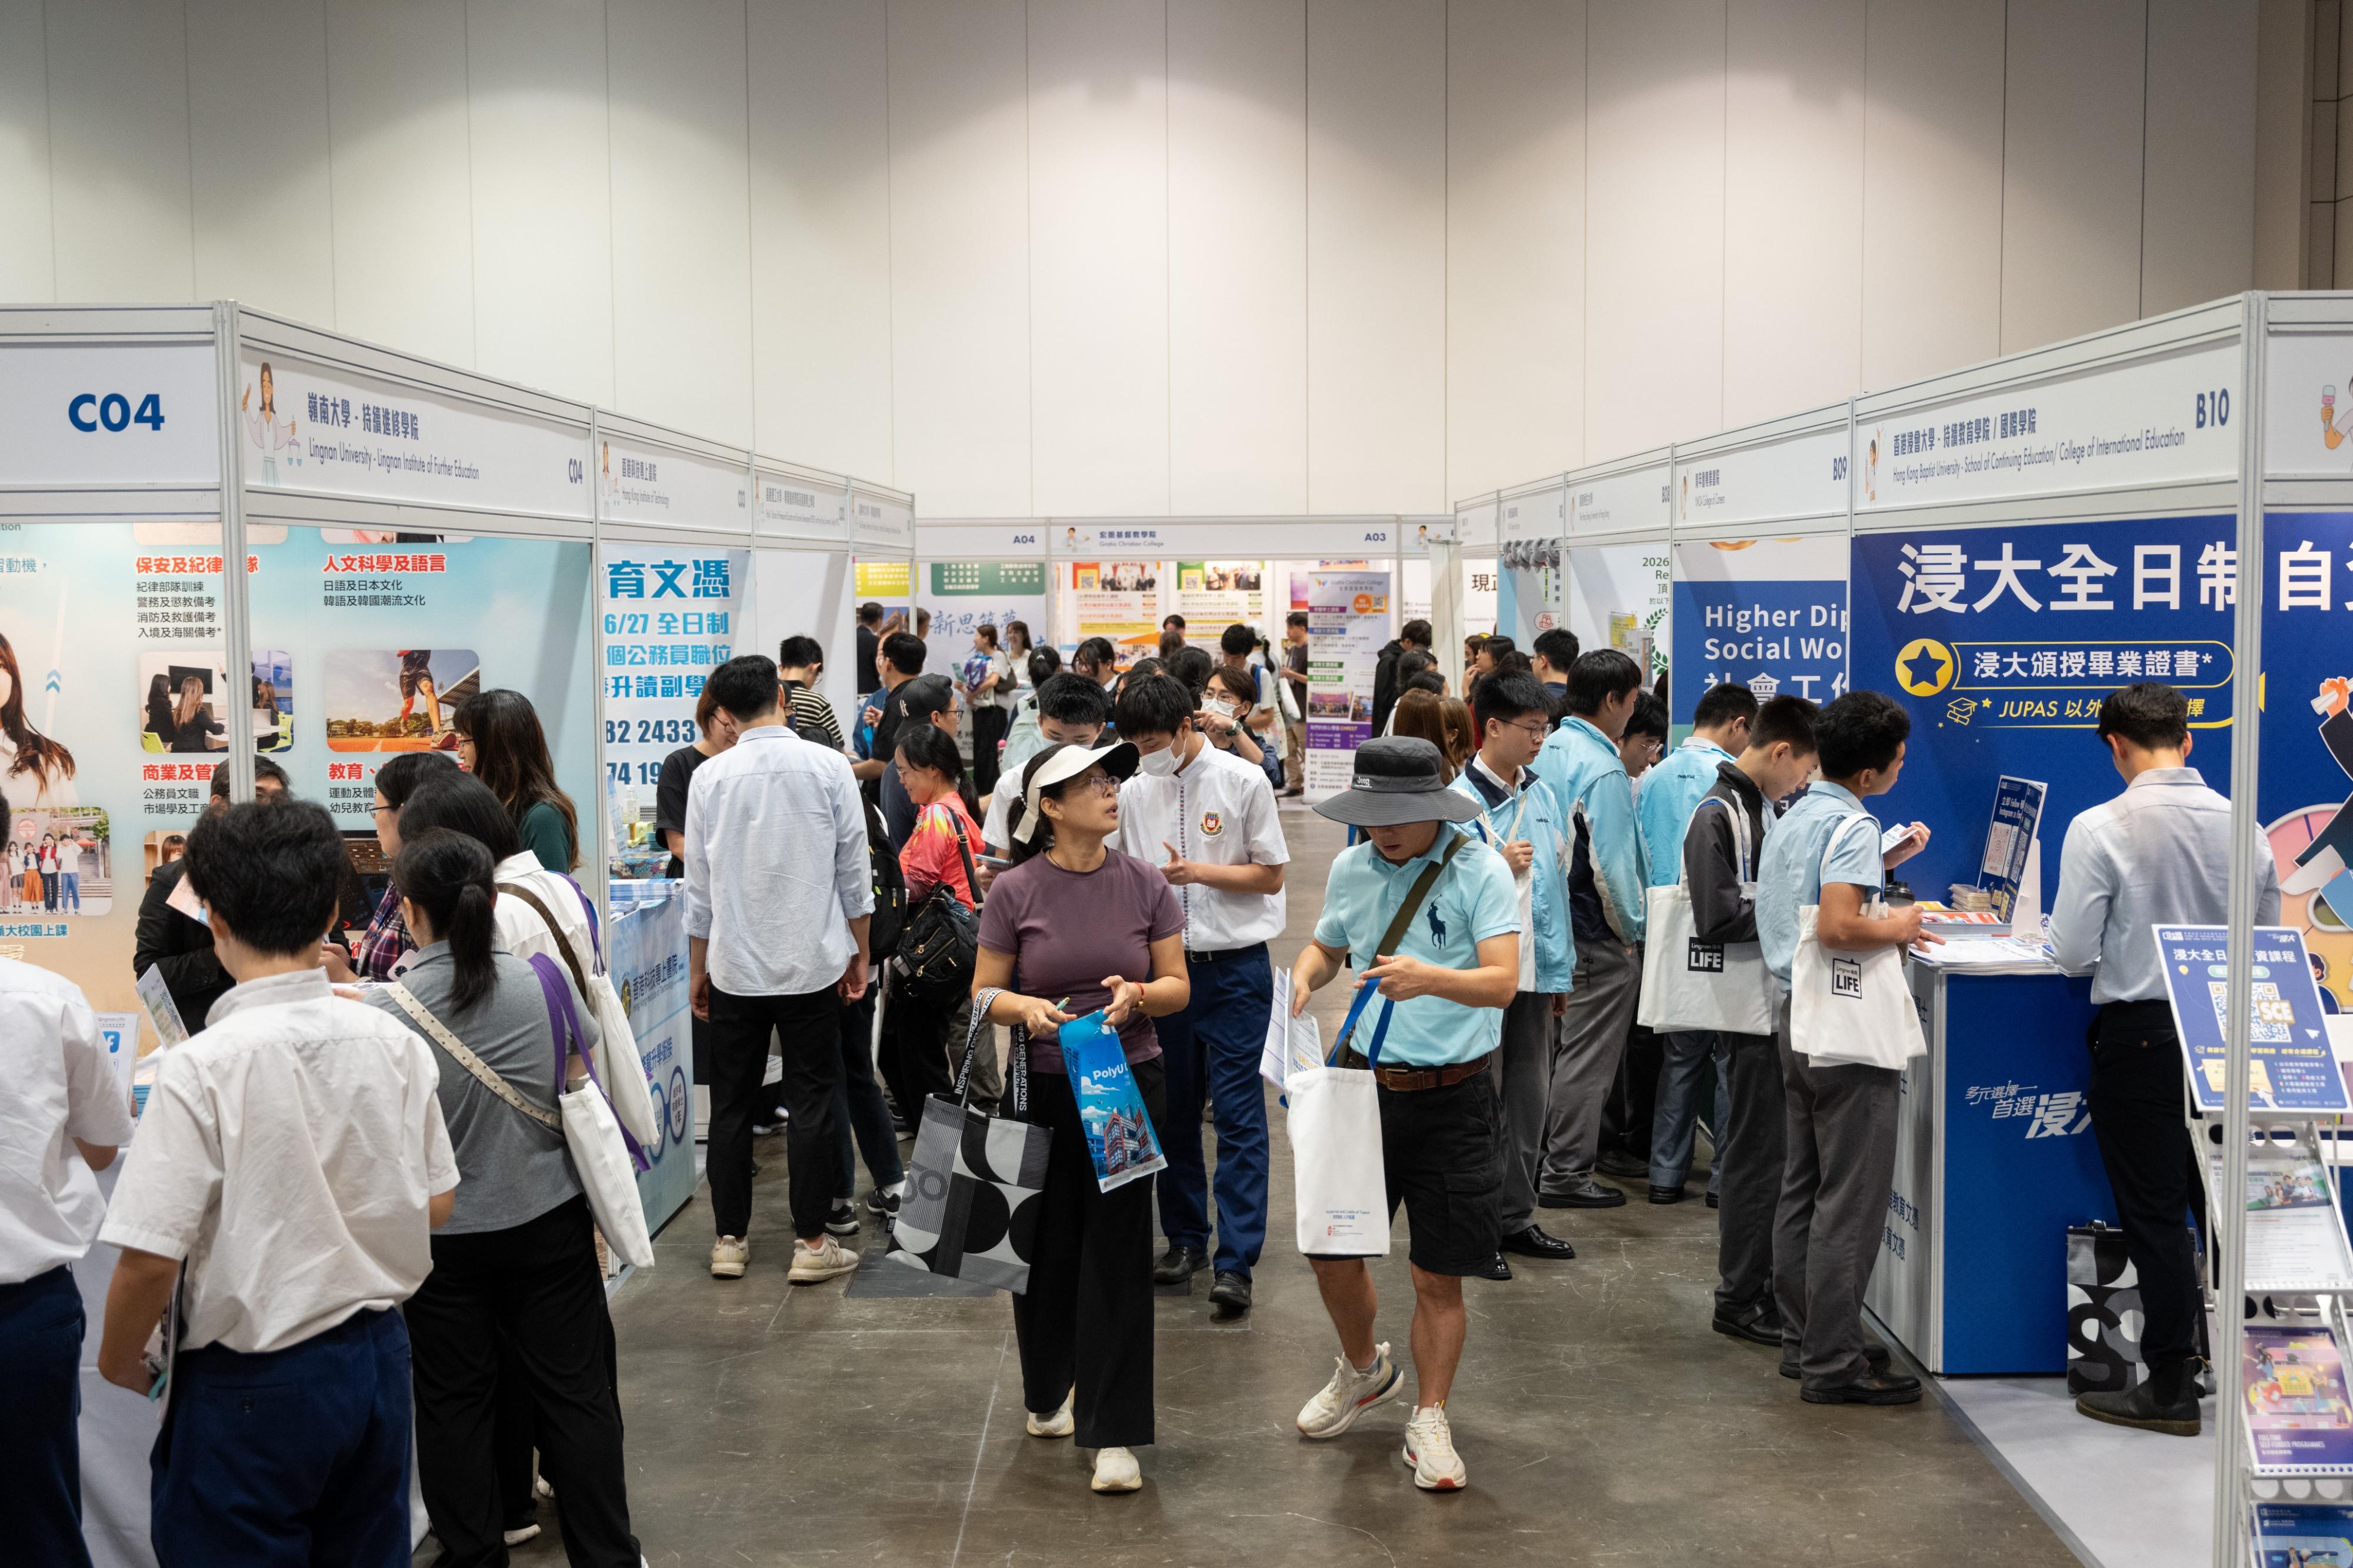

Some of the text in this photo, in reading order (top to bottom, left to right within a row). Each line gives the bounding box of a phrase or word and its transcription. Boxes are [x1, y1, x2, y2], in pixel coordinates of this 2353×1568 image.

[68, 393, 165, 433] C04
[308, 392, 351, 428] 嶺南大學
[362, 403, 419, 440] 持續進修學院
[2196, 388, 2229, 429] B10
[1894, 428, 1934, 456] 香港浸會大學
[1944, 417, 1989, 448] 持續教育學院
[2001, 408, 2037, 439] 國際學院
[309, 436, 338, 465] Lingnan
[339, 441, 372, 471] University
[377, 448, 402, 473] Lingnan
[403, 451, 425, 472] Institute
[427, 454, 434, 473] of
[434, 456, 454, 476] Further
[455, 460, 479, 480] Education
[1894, 467, 1905, 485] Hong
[1907, 465, 1918, 483] Kong
[1919, 463, 1935, 482] Baptist
[1937, 459, 1960, 479] University
[1965, 453, 1982, 472] School
[1984, 450, 1990, 470] of
[1991, 448, 2021, 471] Continuing
[2024, 441, 2058, 466] Education/
[2059, 440, 2085, 464] College
[2088, 436, 2095, 457] of
[2097, 429, 2143, 456] International
[2145, 426, 2185, 450] Education
[569, 458, 583, 484] C04
[1833, 456, 1847, 481] B09
[1662, 485, 1670, 503] B08
[1014, 535, 1035, 544] A04
[1365, 533, 1386, 542] A03
[0, 558, 47, 573] 動機，
[136, 556, 259, 573] 保安及紀律隊
[323, 555, 446, 572] 人文科學及語言
[1642, 558, 1669, 566] 2026
[136, 581, 204, 592] 紀律部隊訓練
[324, 580, 402, 591] 日語及日本文化
[602, 559, 730, 598] 育文憑
[136, 596, 215, 608] 警務及懲教備考
[324, 595, 425, 606] 韓語及韓國潮流文化
[137, 612, 216, 623] 消防及救護備考
[658, 612, 729, 635] 全日制
[1706, 604, 1801, 633] Higher
[606, 645, 731, 665] 個公務員職位
[1705, 636, 1842, 660] Social Wo
[1998, 701, 2058, 717] JUPAS
[638, 720, 695, 743] 2433
[143, 764, 215, 781] 商業及管
[1357, 776, 1369, 785] Jeep
[143, 788, 199, 799] 公務員文職
[1691, 952, 1721, 968] LIFE
[2173, 949, 2297, 963] 浸大全日資課程
[1837, 966, 1851, 974] Lingnan
[1836, 975, 1859, 992] LIFE
[2259, 1001, 2292, 1022] SCE
[954, 1050, 974, 1095] INSPIRING
[1019, 1044, 1027, 1111] GENERATIONS
[1093, 1064, 1124, 1080] PolyU
[1965, 1084, 2019, 1102] 多元選擇
